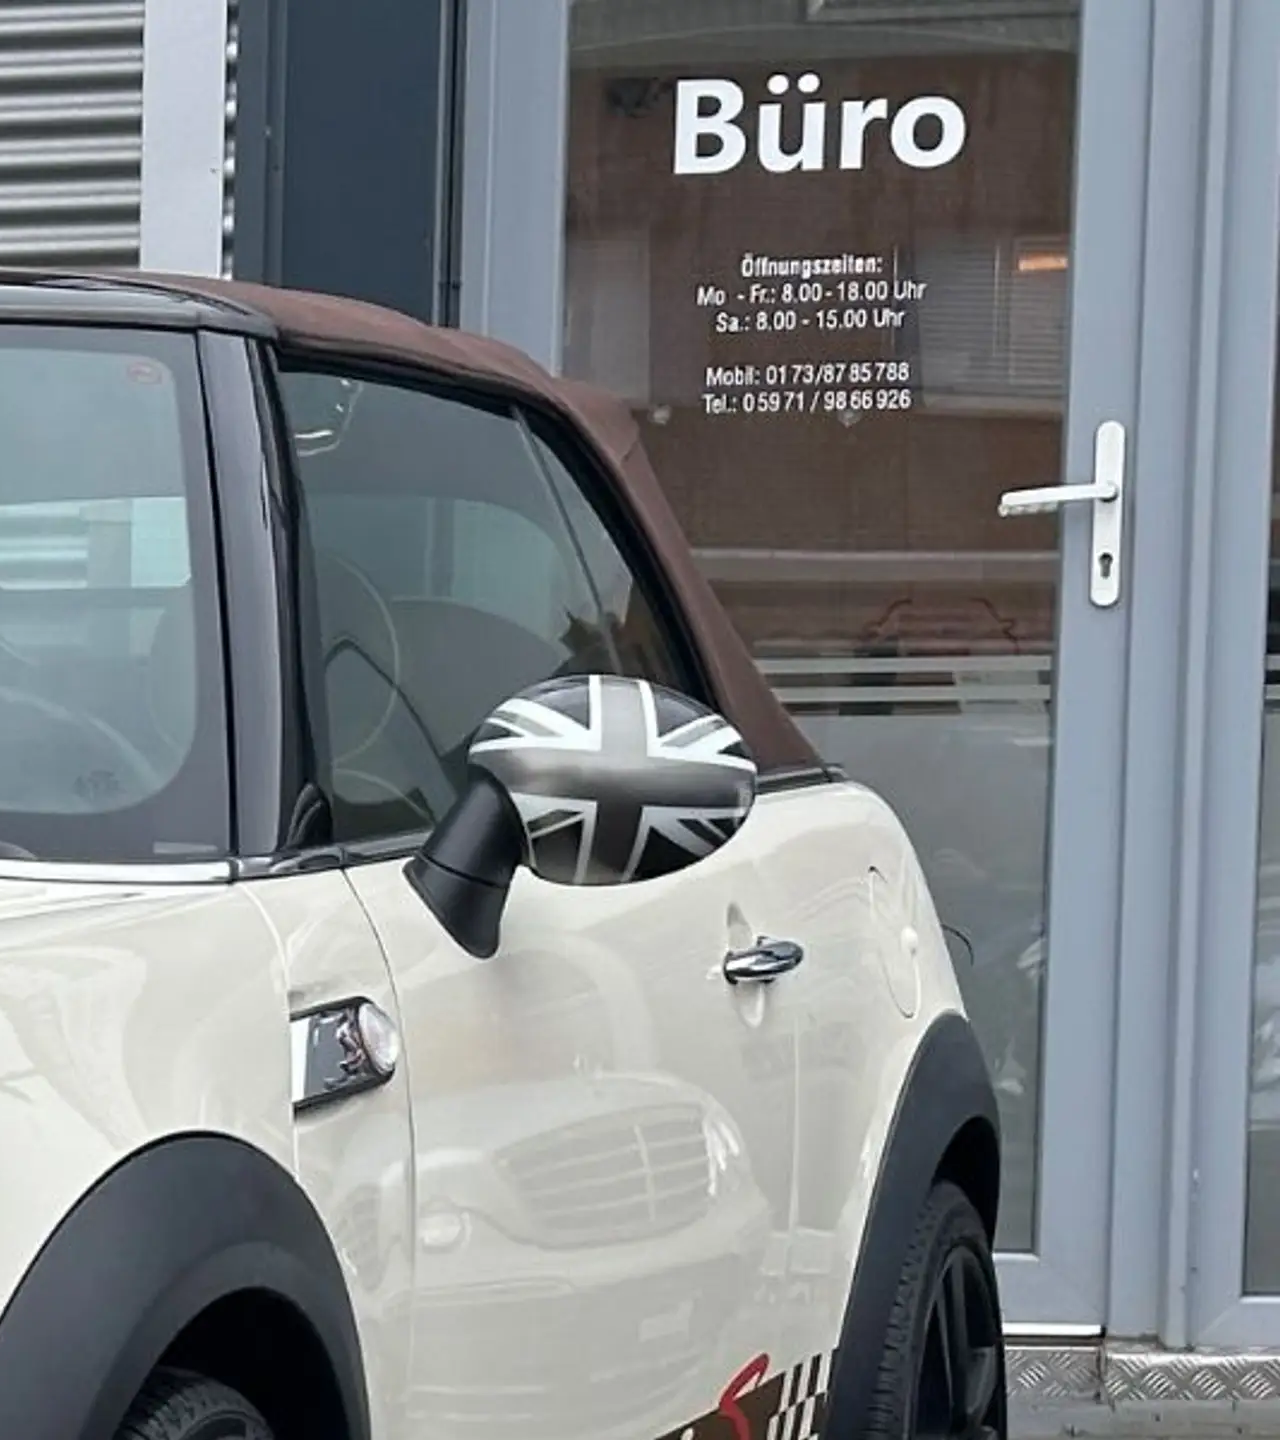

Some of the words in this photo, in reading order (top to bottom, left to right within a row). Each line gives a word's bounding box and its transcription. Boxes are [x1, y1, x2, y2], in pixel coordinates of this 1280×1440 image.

[673, 74, 966, 174] Büro
[742, 253, 883, 279] Öffnungszeiten:
[781, 283, 823, 302] 8.00
[837, 281, 888, 301] 18.00
[893, 281, 928, 300] Uhr
[715, 312, 750, 332] Sa.:
[756, 311, 797, 331] 8.00
[817, 309, 867, 330] 15.00
[873, 308, 905, 328] Uhr
[706, 366, 760, 386] Mobil:
[702, 393, 737, 414] Tel.:
